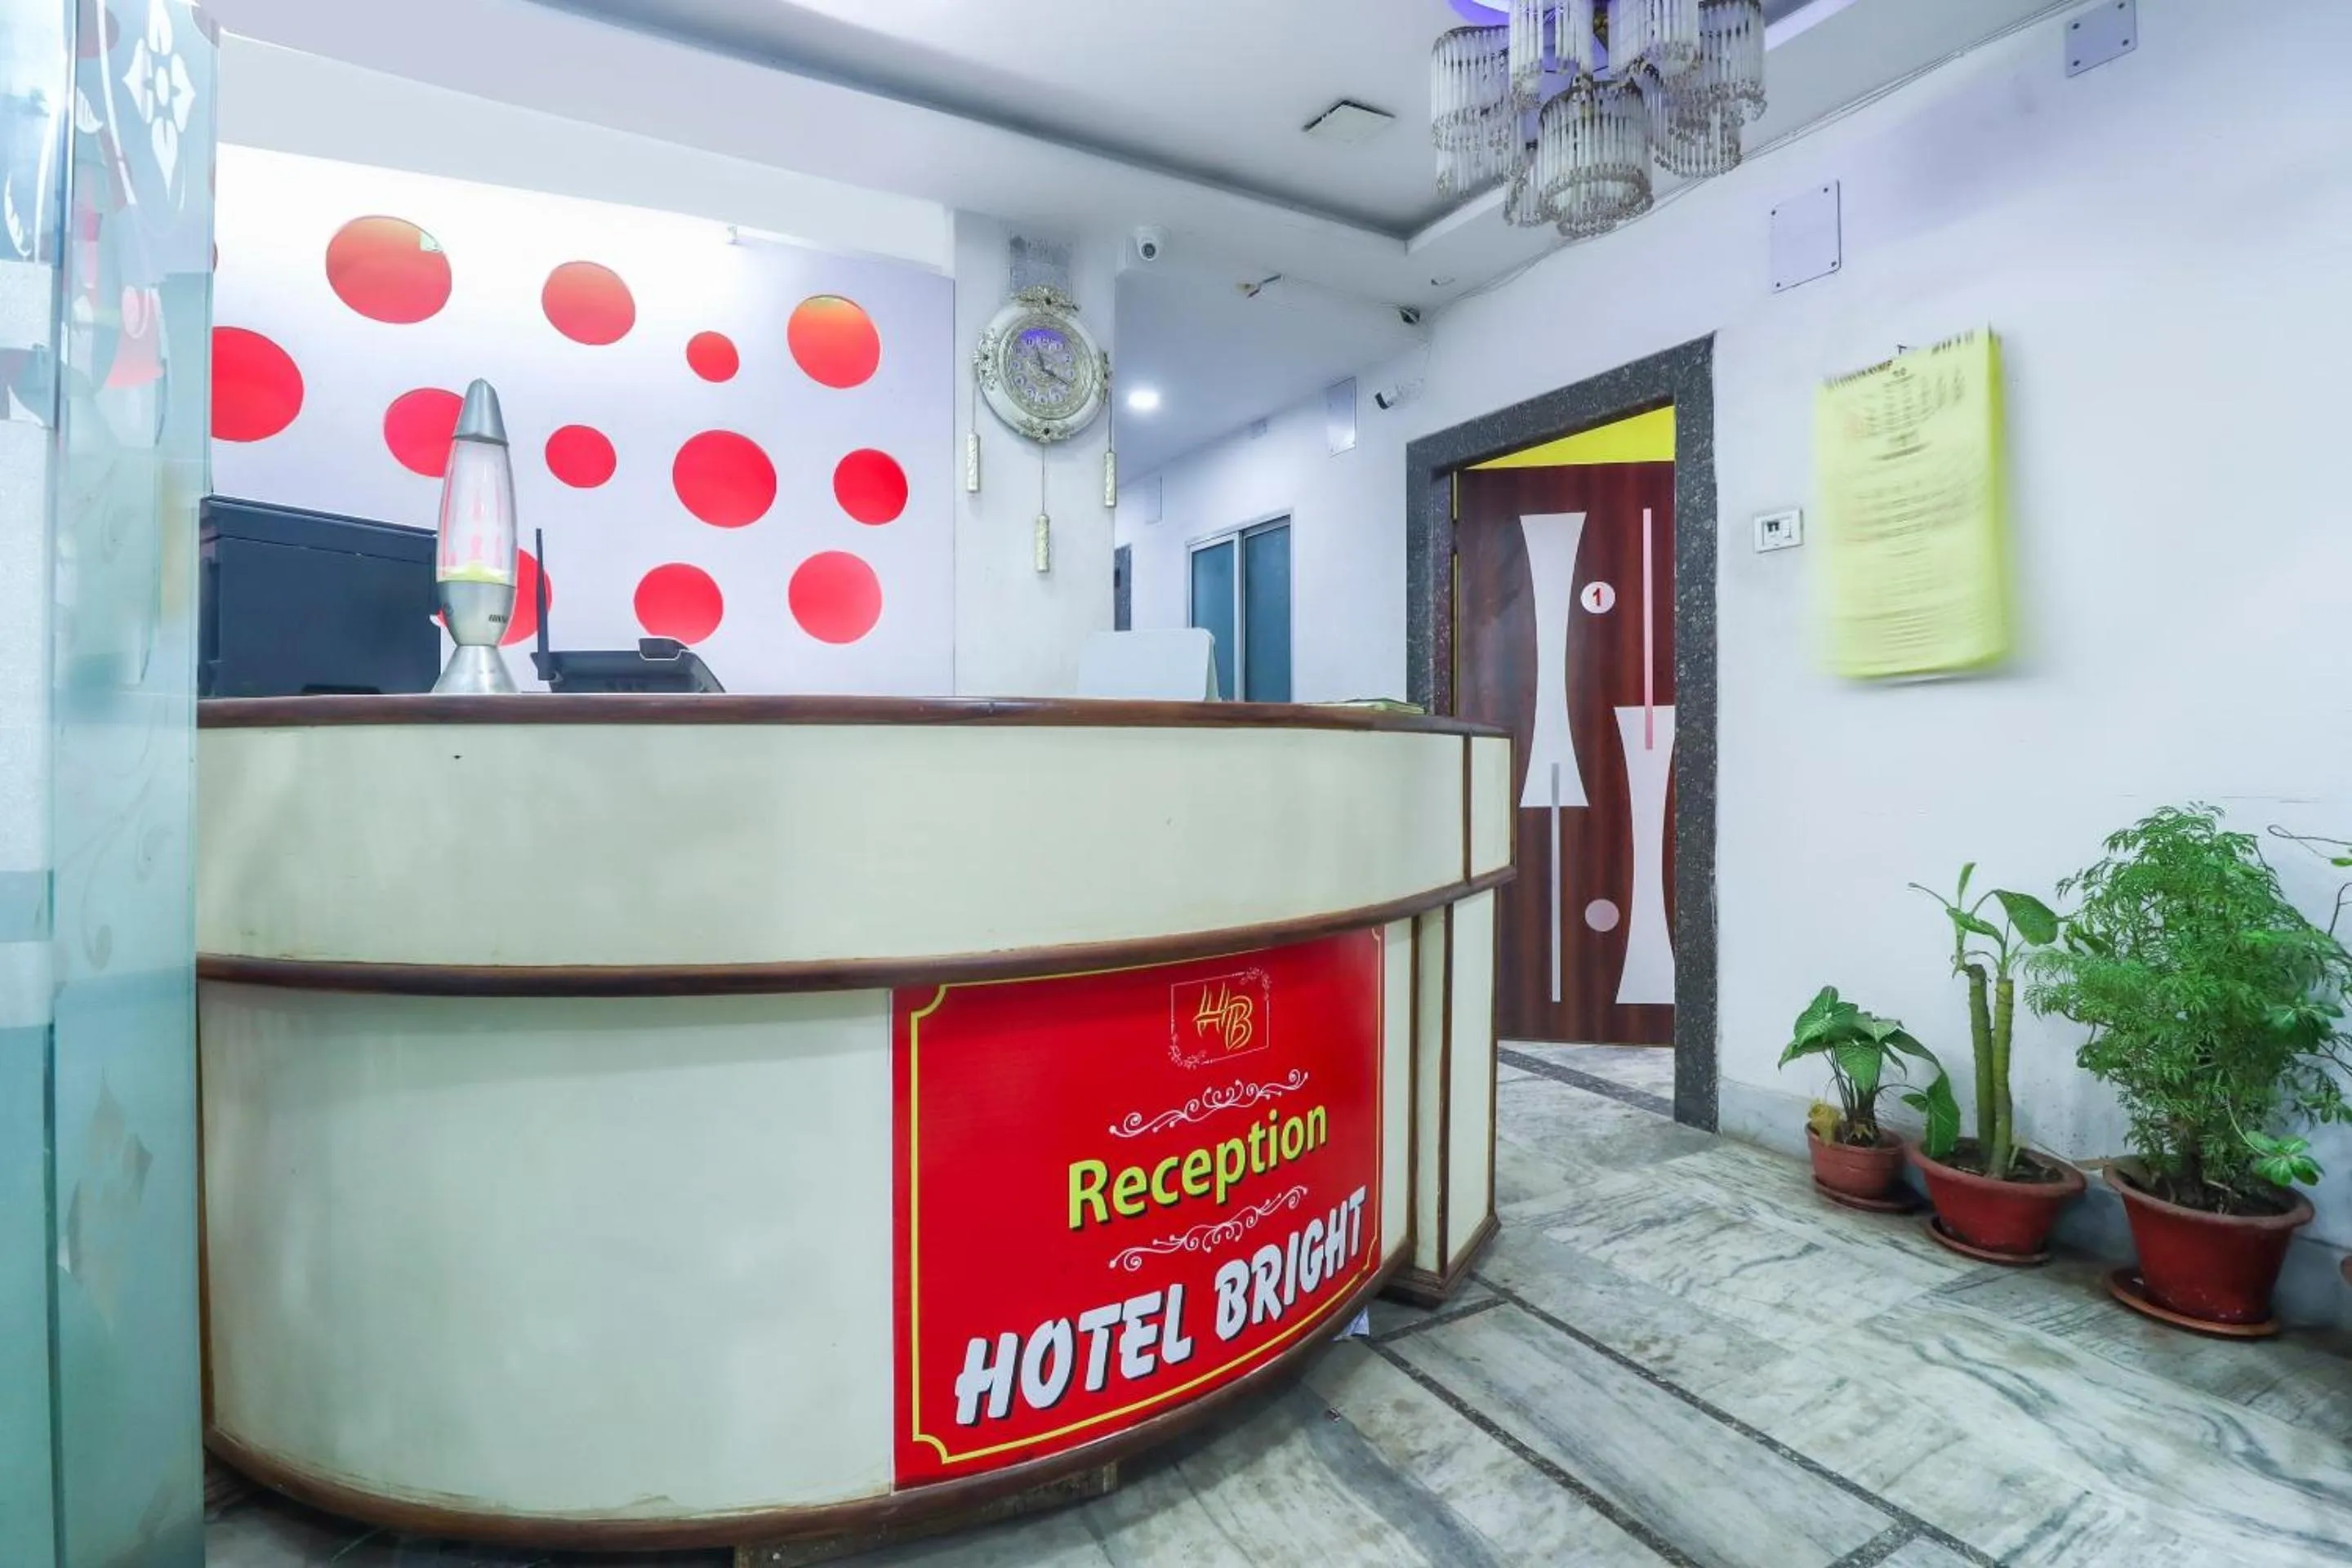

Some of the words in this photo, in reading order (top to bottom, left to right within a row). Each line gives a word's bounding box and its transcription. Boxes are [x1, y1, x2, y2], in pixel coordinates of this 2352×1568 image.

[1592, 587, 1601, 607] 1
[1192, 981, 1253, 1051] HB
[1067, 1104, 1327, 1229] Reception
[954, 1283, 1193, 1425] HOTEL
[1214, 1186, 1367, 1341] BRIGHT
